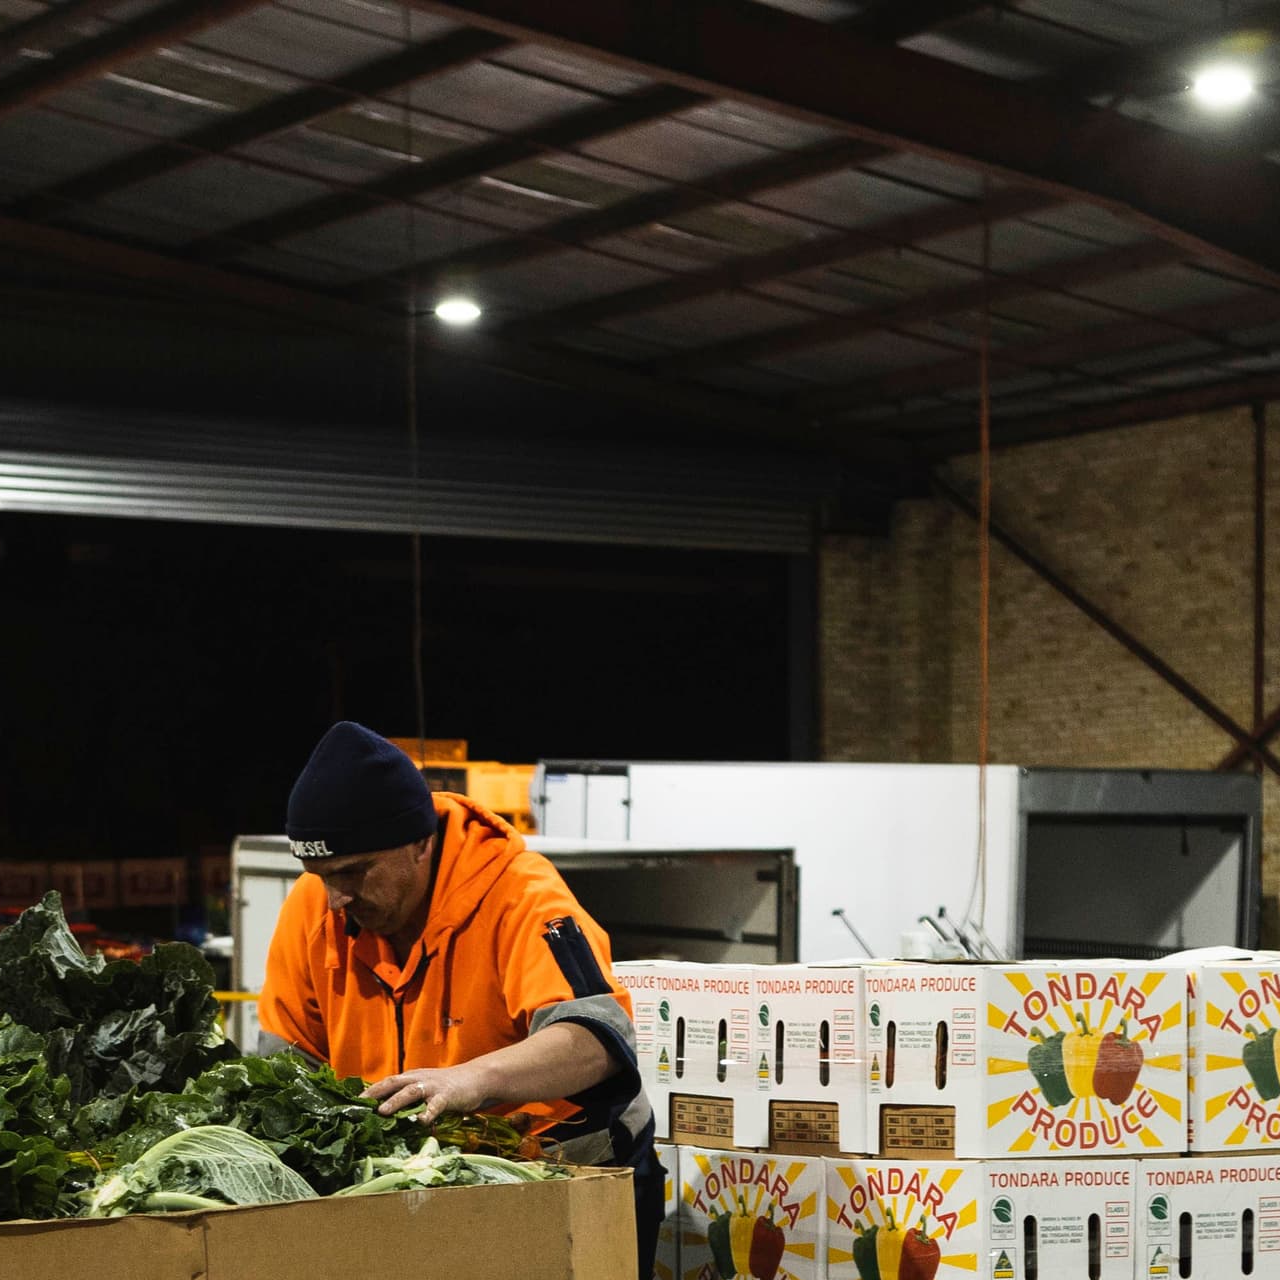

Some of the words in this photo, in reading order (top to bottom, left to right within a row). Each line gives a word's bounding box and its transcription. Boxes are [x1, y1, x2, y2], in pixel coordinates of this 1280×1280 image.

[657, 977, 700, 991] TONDARA
[704, 980, 749, 994] PRODUCE
[756, 980, 801, 994] TONDARA
[805, 980, 854, 994] PRODUCE
[866, 978, 916, 992] TONDARA
[921, 977, 976, 991] PRODUCE
[1004, 972, 1163, 1043] TONDARA
[1013, 1088, 1159, 1149] PRODUCE
[990, 1172, 1059, 1188] TONDARA
[1065, 1171, 1130, 1186] PRODUCE
[1147, 1170, 1214, 1186] TONDARA
[694, 1158, 800, 1230] TONDARA
[837, 1167, 959, 1241] TONDARA
